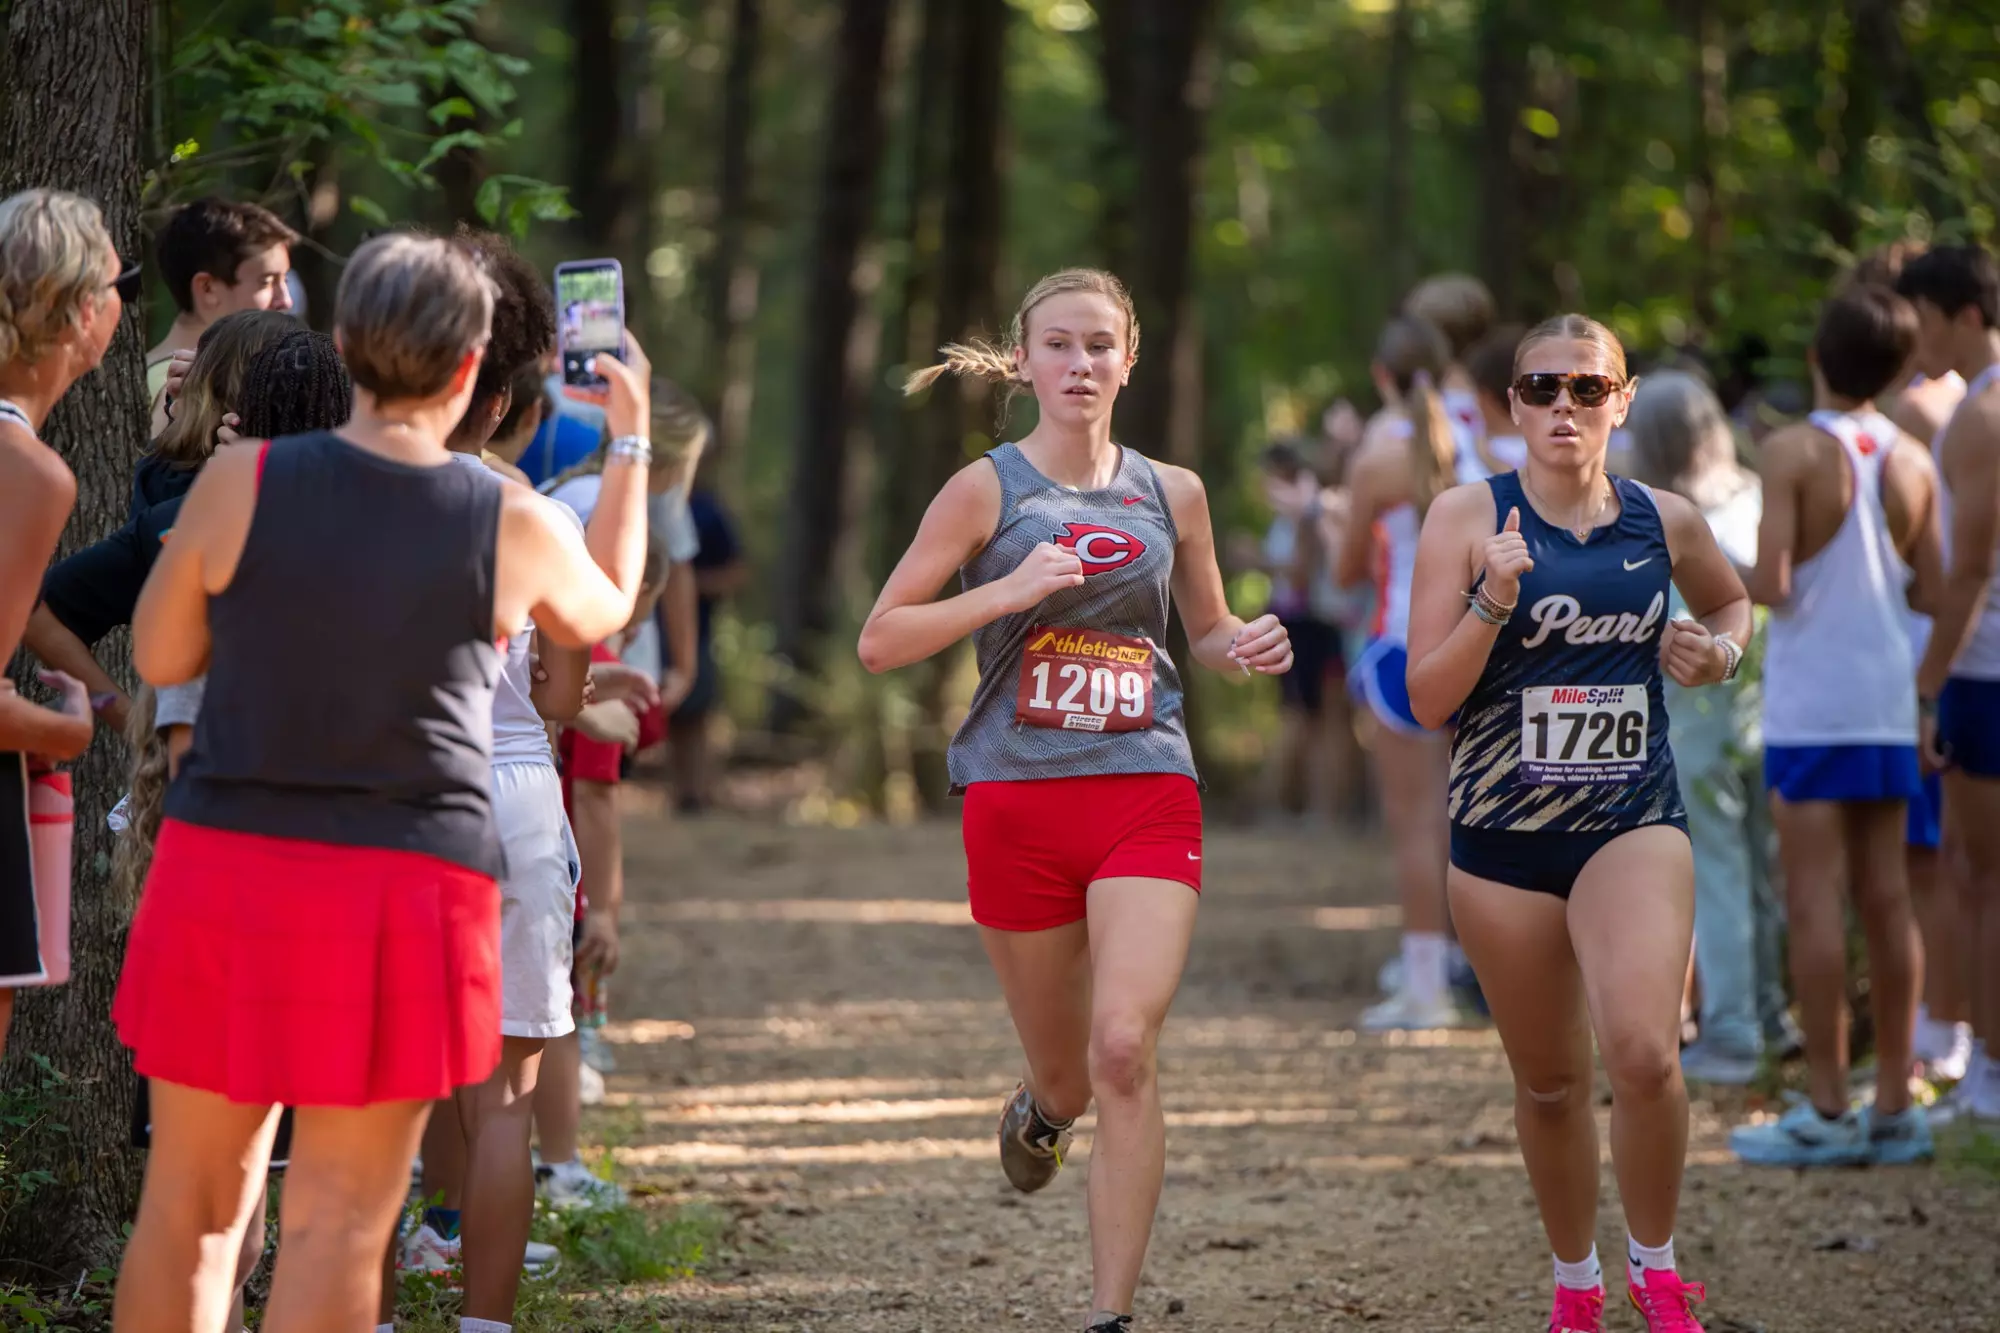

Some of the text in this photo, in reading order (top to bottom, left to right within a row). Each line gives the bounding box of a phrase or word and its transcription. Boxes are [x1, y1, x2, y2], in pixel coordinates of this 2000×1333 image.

[1522, 590, 1664, 649] Pearl
[1029, 662, 1145, 718] 1209
[1551, 688, 1624, 707] MileSplit
[1529, 710, 1644, 760] 1726
[1545, 764, 1562, 772] home
